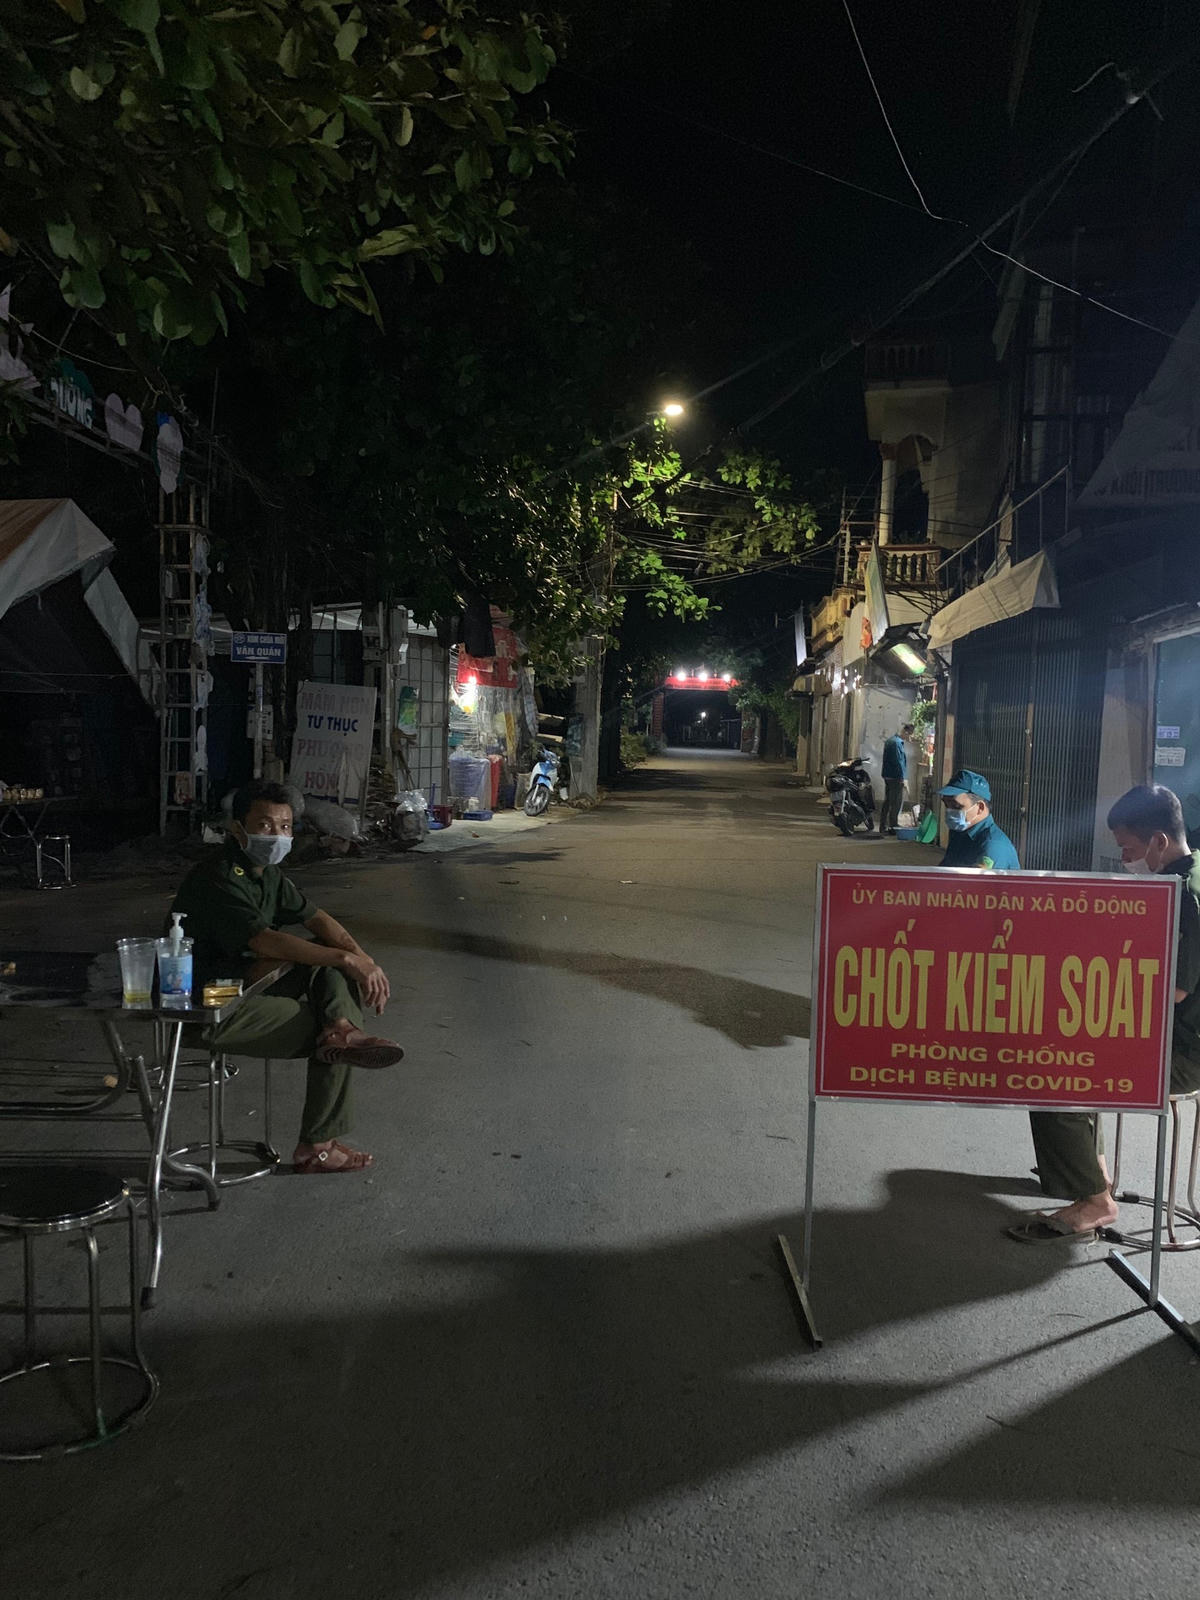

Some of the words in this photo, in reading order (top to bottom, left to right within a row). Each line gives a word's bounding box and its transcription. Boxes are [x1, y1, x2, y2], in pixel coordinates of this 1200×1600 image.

[307, 714, 325, 730] TƯ
[326, 715, 360, 737] THỤC
[852, 882, 877, 905] ỦY
[883, 890, 921, 906] BAN
[927, 889, 979, 909] NHÂN
[985, 892, 1024, 911] DÂN
[1030, 893, 1056, 912] XÃ
[1062, 890, 1089, 913] ĐỖ
[1094, 895, 1147, 919] ĐỘNG
[833, 918, 935, 1030] CHỐT
[945, 918, 1046, 1035] KIỂM
[1057, 939, 1160, 1039] SOÁT
[891, 1041, 988, 1062] PHÒNG
[997, 1043, 1095, 1067] CHỐNG
[850, 1066, 915, 1087] DỊCH
[925, 1067, 997, 1090] BỆNH
[1006, 1074, 1133, 1093] COVID-19
